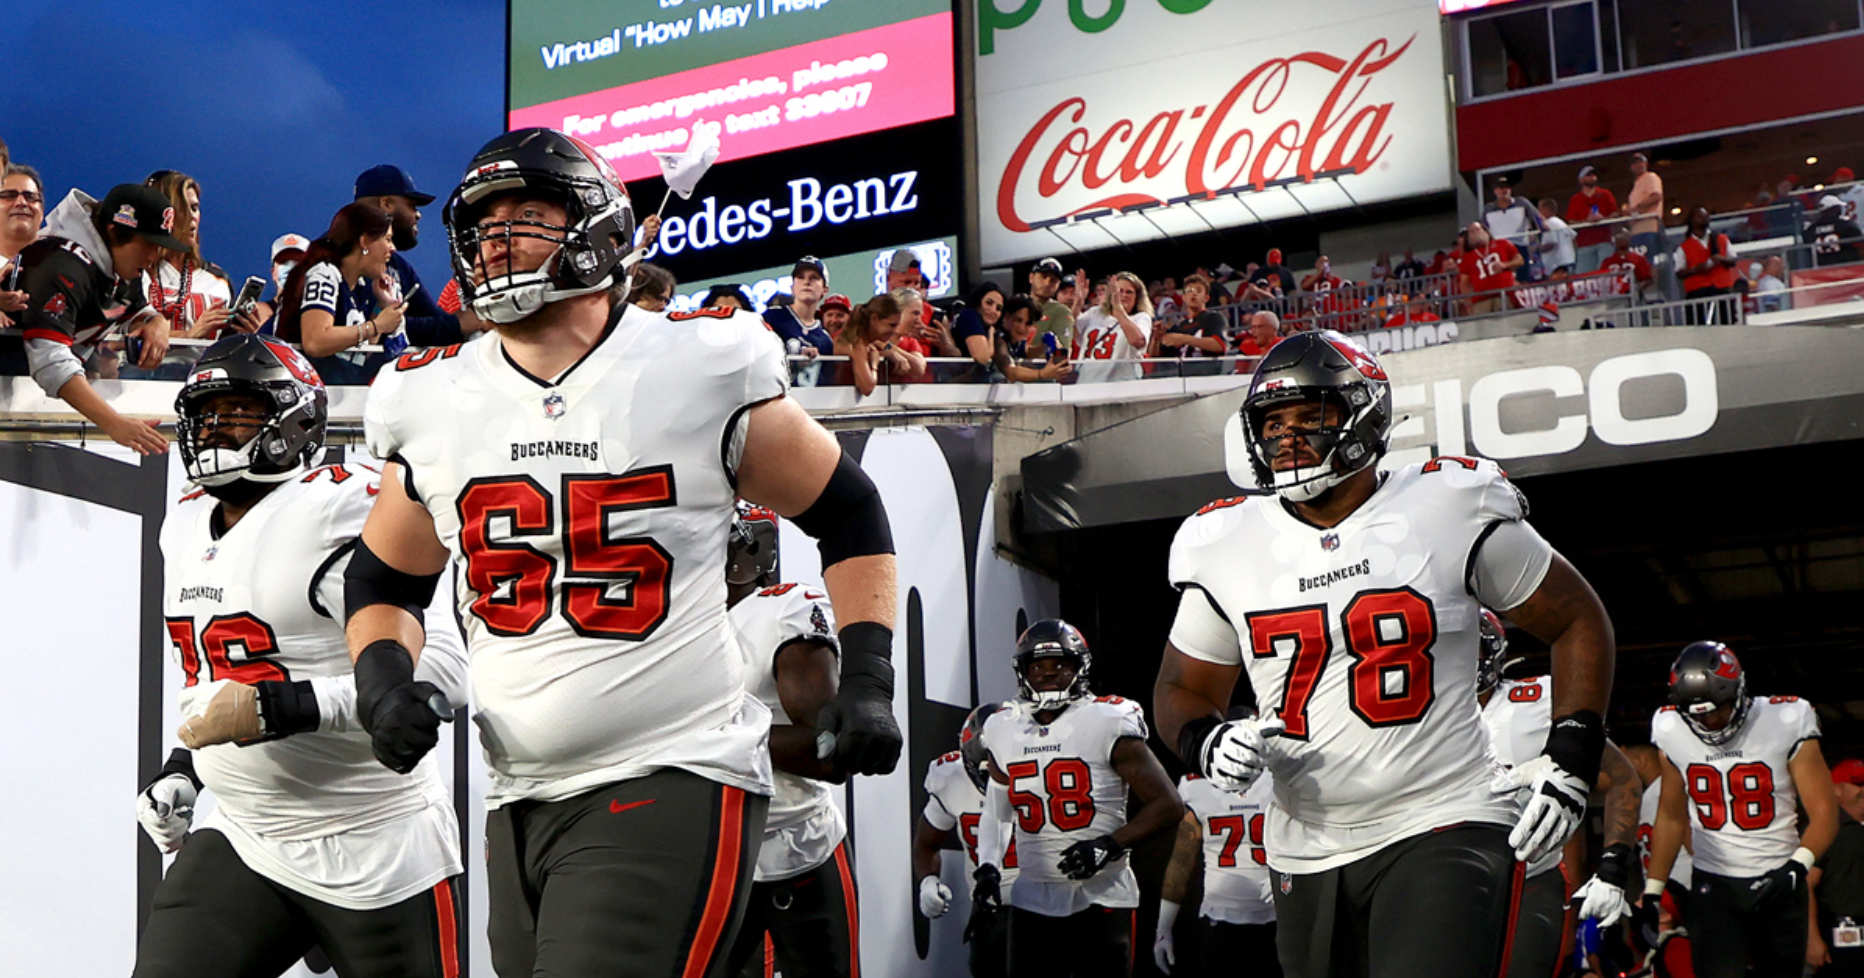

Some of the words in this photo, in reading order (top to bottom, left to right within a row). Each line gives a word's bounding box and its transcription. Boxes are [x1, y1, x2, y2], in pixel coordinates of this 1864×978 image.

[541, 28, 620, 69] Virtual
[698, 3, 752, 32] May
[772, 0, 829, 15] He
[563, 114, 607, 136] For
[594, 128, 689, 159] ontinue
[997, 32, 1417, 232] Coca-Cola
[1474, 251, 1502, 280] 12
[305, 281, 335, 305] 82
[1084, 327, 1118, 360] 13
[1224, 348, 1719, 490] EICO
[511, 441, 599, 461] BUCCANEERS
[455, 464, 677, 641] 65
[1299, 559, 1370, 592] BUCCANEERS
[1244, 585, 1438, 741] 78
[1006, 757, 1096, 834] 58
[1685, 762, 1776, 831] 98
